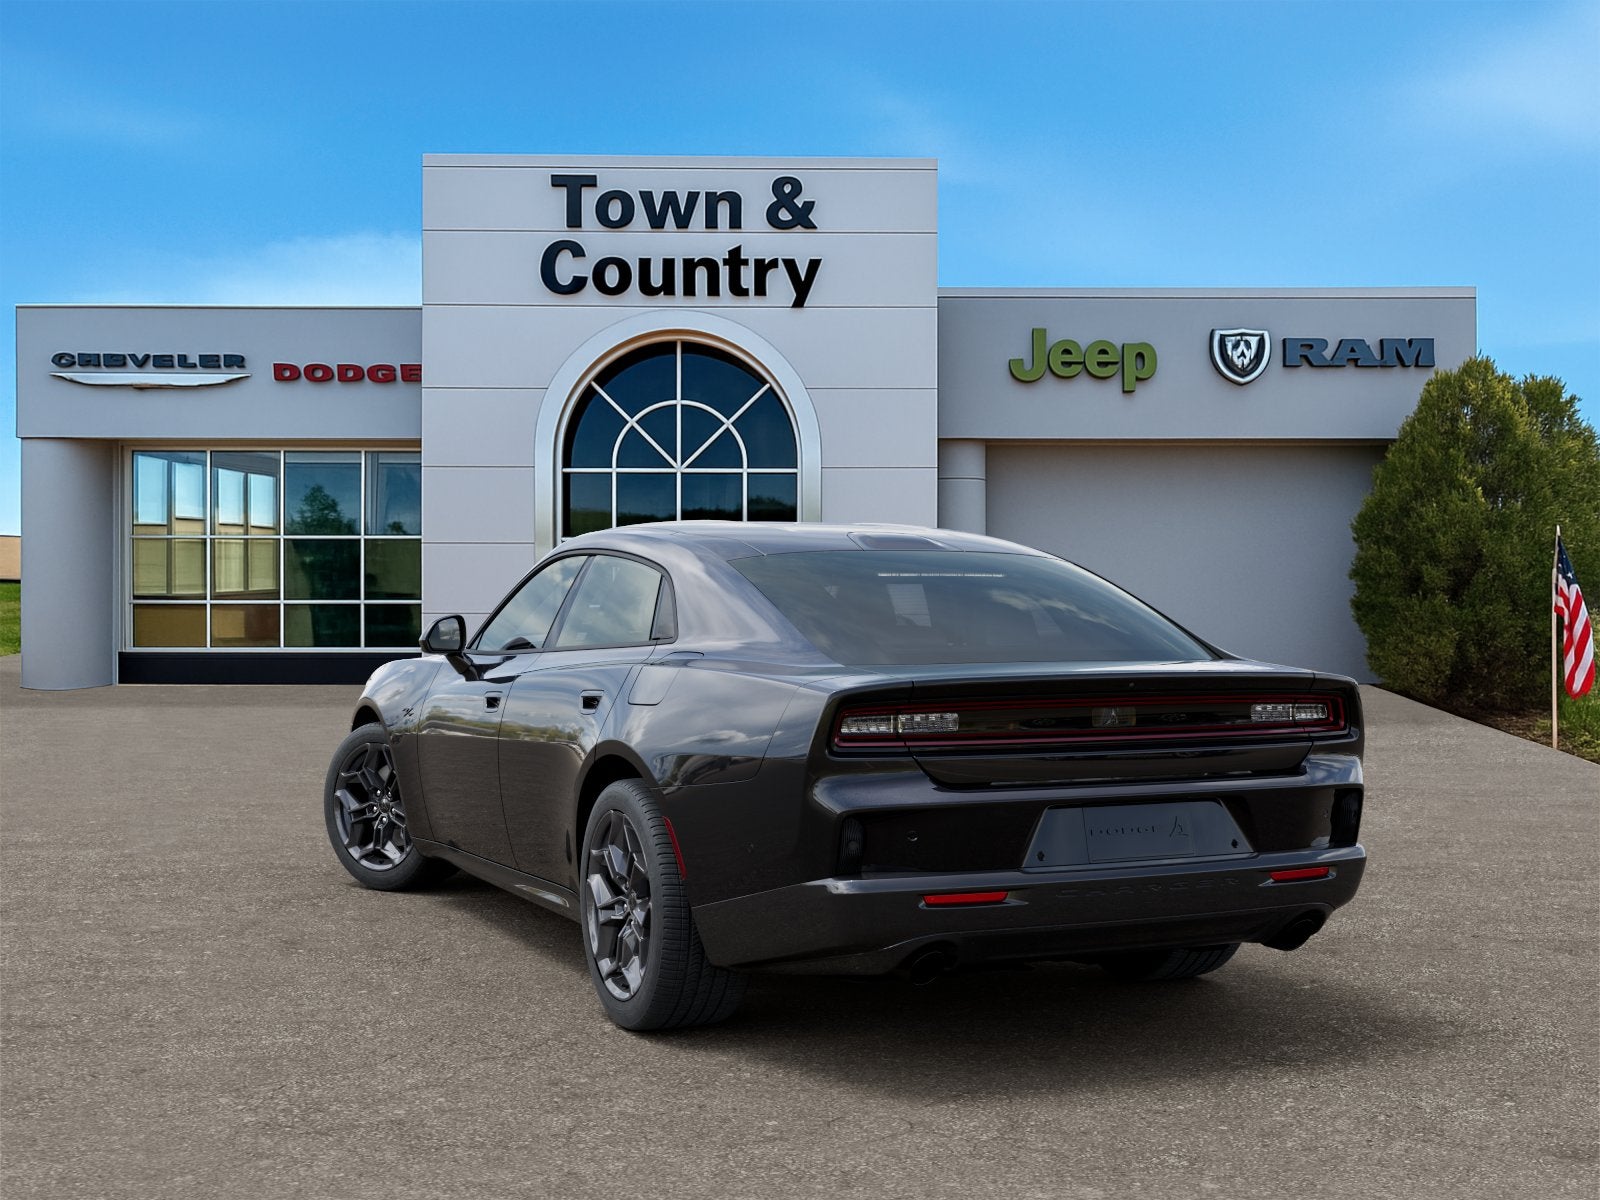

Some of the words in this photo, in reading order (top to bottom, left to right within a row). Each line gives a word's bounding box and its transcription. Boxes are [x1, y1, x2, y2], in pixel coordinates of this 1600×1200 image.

[550, 174, 743, 230] Town
[765, 175, 818, 230] &
[540, 239, 823, 309] Country
[272, 363, 422, 383] DODGE
[1008, 327, 1158, 393] Jeep
[1282, 337, 1436, 368] RAM
